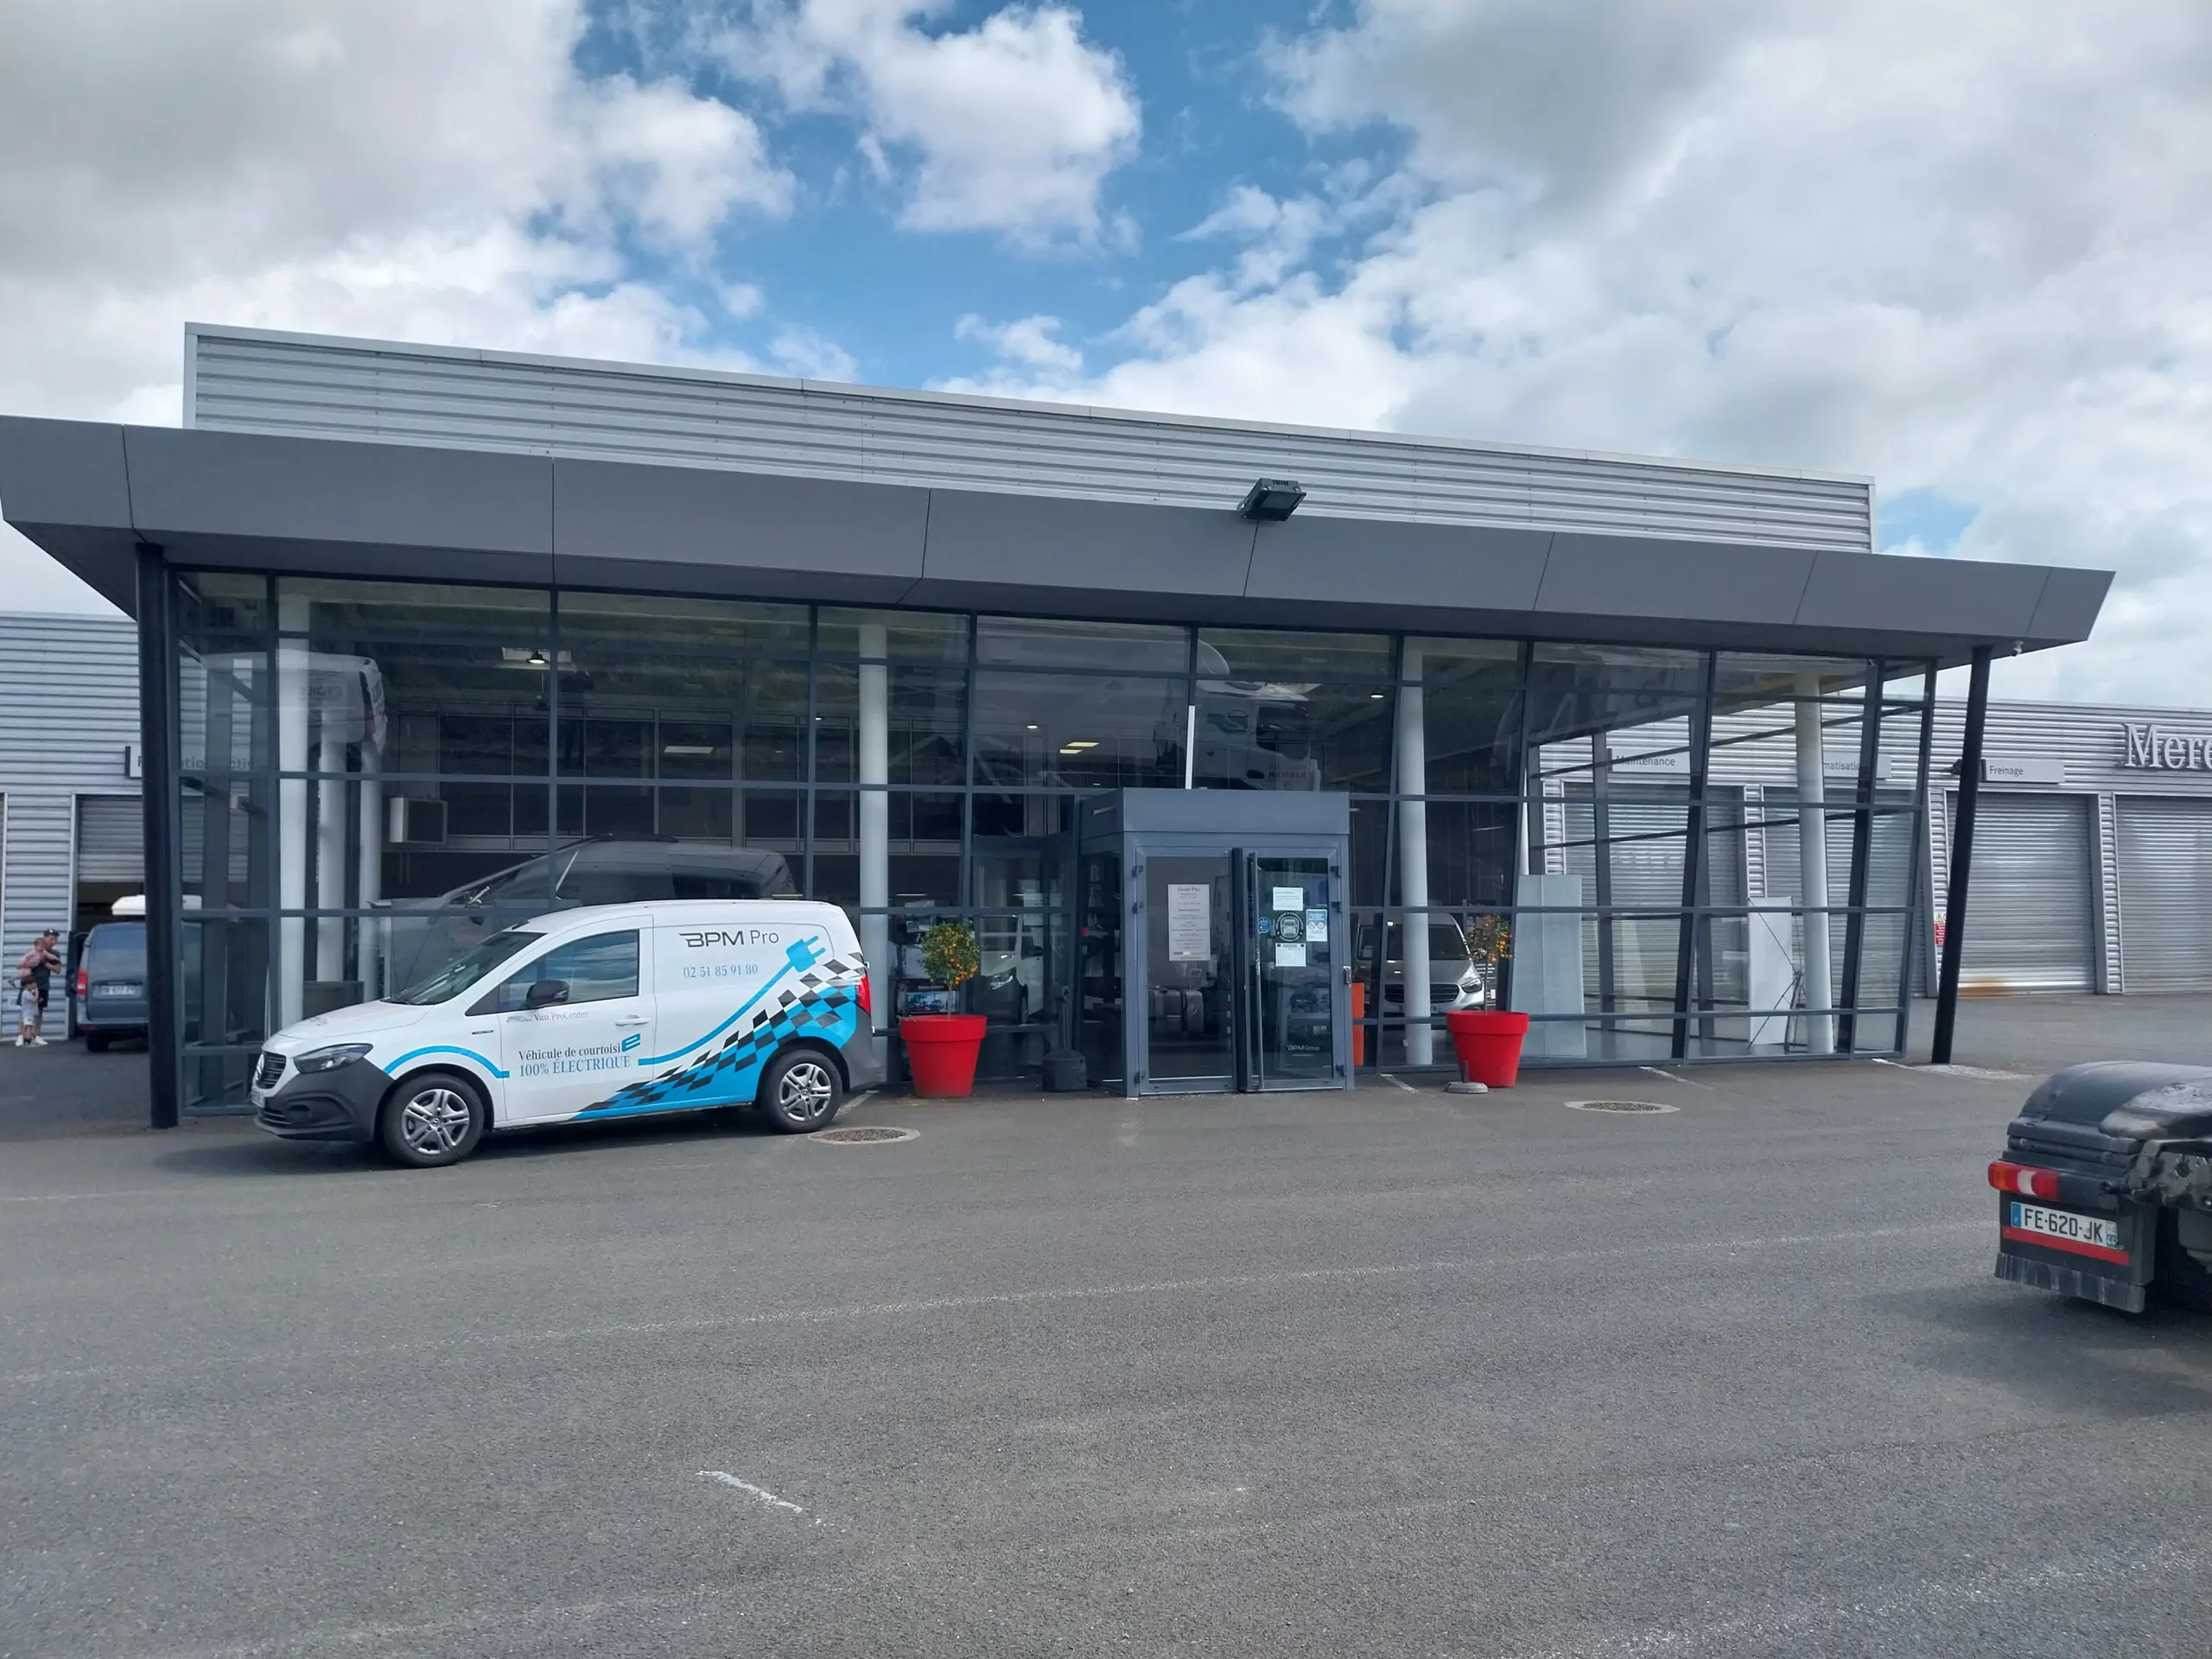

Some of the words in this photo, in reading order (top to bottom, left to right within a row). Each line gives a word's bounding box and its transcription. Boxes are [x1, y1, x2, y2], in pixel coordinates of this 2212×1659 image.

[1989, 765, 2024, 778] Freinage
[679, 931, 744, 948] BPM
[750, 930, 779, 944] Pro
[683, 966, 696, 979] 02
[700, 966, 711, 978] 51
[715, 965, 728, 977] 85
[730, 964, 741, 976] 91
[745, 963, 759, 975] 80
[533, 1013, 550, 1022] Van
[551, 1011, 589, 1021] ProCenter
[518, 1046, 563, 1061] Véhicule
[564, 1046, 576, 1058] de
[519, 1063, 550, 1077] 100%
[552, 1055, 631, 1075] ÉLECTRIQUE
[2024, 1207, 2104, 1243] FE-620-JK
